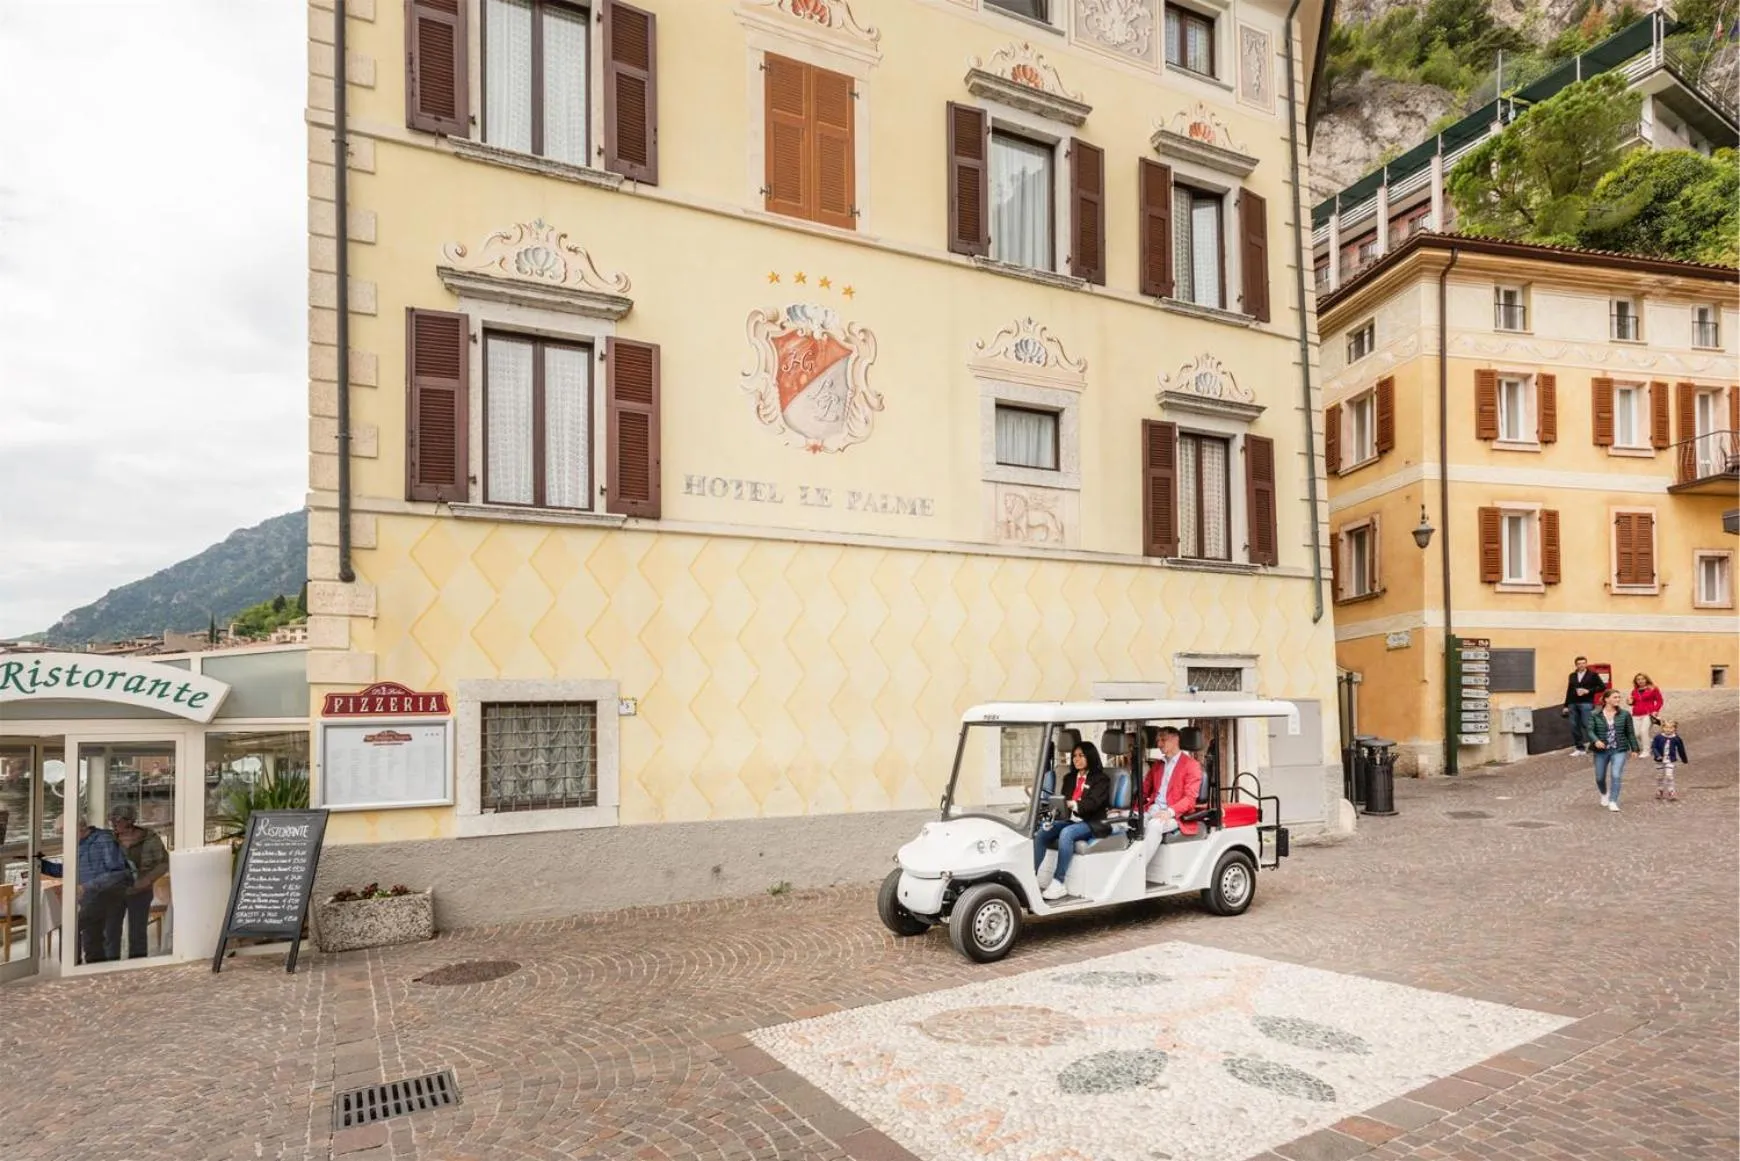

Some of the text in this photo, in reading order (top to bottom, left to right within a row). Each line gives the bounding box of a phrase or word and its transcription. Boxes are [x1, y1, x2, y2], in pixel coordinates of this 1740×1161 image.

[683, 474, 935, 517] HOTEL LE PALME
[0, 659, 209, 708] Ristorante
[333, 697, 438, 713] PIZZERIA
